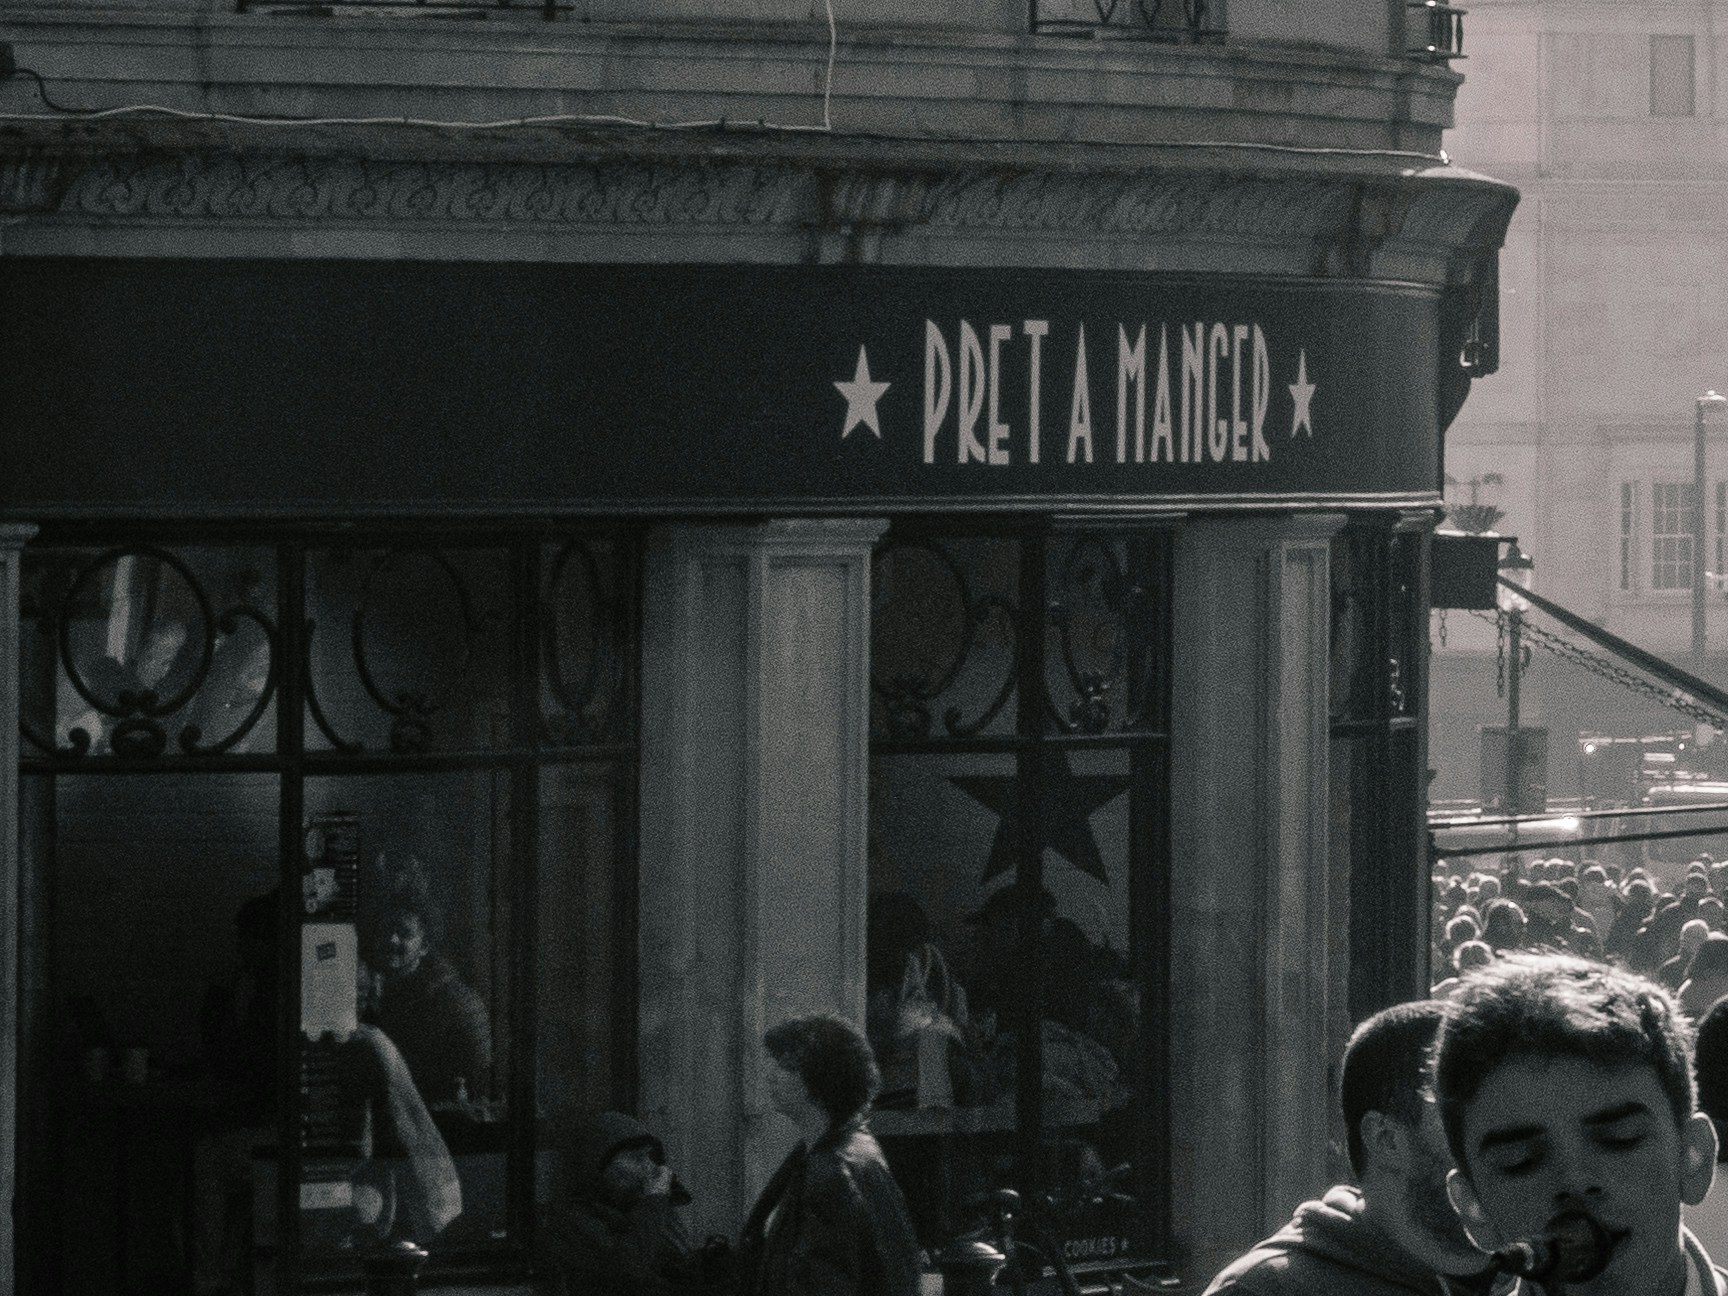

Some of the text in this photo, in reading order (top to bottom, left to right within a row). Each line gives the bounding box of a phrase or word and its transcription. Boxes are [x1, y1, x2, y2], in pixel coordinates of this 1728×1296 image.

[923, 317, 1271, 465] PRET A MANGER
[1063, 1236, 1117, 1258] COOKIES
